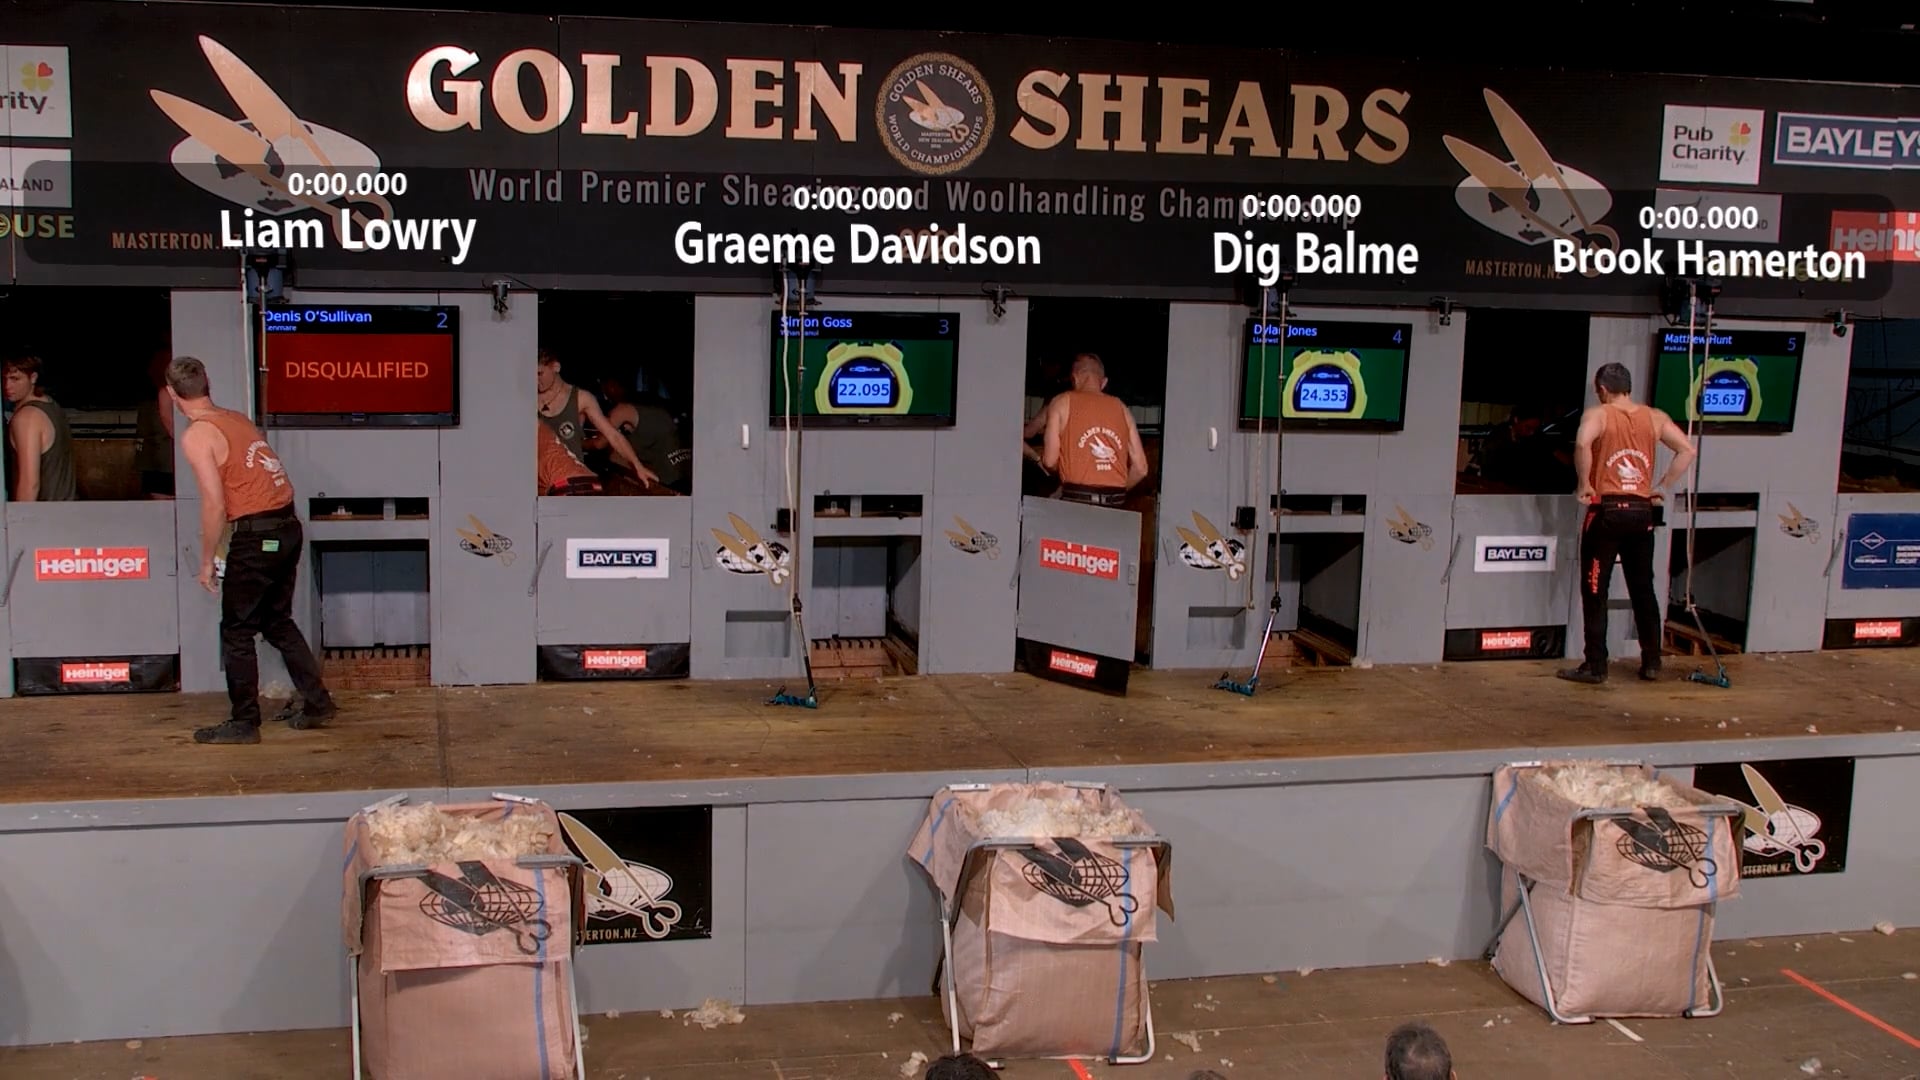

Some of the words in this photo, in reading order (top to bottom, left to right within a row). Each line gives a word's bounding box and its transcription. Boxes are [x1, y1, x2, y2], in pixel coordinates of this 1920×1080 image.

[889, 64, 935, 102] GOLDEN
[939, 64, 983, 104] SHEARS
[406, 45, 864, 142] GOLDEN
[1009, 69, 1412, 165] SHEARS
[888, 113, 911, 152] WORLD
[910, 115, 984, 164] CHAMPIONSHIPS
[1673, 125, 1714, 141] Pub
[1787, 124, 1920, 159] BAYLEY
[1672, 143, 1746, 165] Charity
[468, 169, 564, 203] World
[580, 171, 706, 205] Premier
[945, 180, 1146, 222] Woolhandling
[264, 309, 301, 323] Denis
[305, 309, 372, 323] O'Sullivan
[436, 312, 448, 328] 2
[822, 316, 853, 328] Goss
[264, 323, 297, 332] enmare
[938, 319, 950, 335] 3
[1286, 325, 1318, 338] Jones
[1392, 329, 1403, 344] 4
[1707, 334, 1733, 346] Hunt
[1787, 337, 1797, 351] 5
[285, 361, 429, 381] DISQUALIFIED
[838, 383, 890, 397] 22.095
[1302, 388, 1348, 402] 24.353
[1704, 393, 1745, 406] 35.637
[40, 548, 146, 576] Heiniger
[582, 552, 653, 564] BAYLEYS
[1043, 541, 1118, 574] Heiniger
[1487, 548, 1544, 560] BAYLEYS
[1856, 622, 1899, 636] Heiniger
[1482, 632, 1530, 648] Heiniger
[587, 650, 644, 668] Heiniger
[1051, 653, 1097, 674] Heiniger
[66, 663, 129, 680] Heiniger
